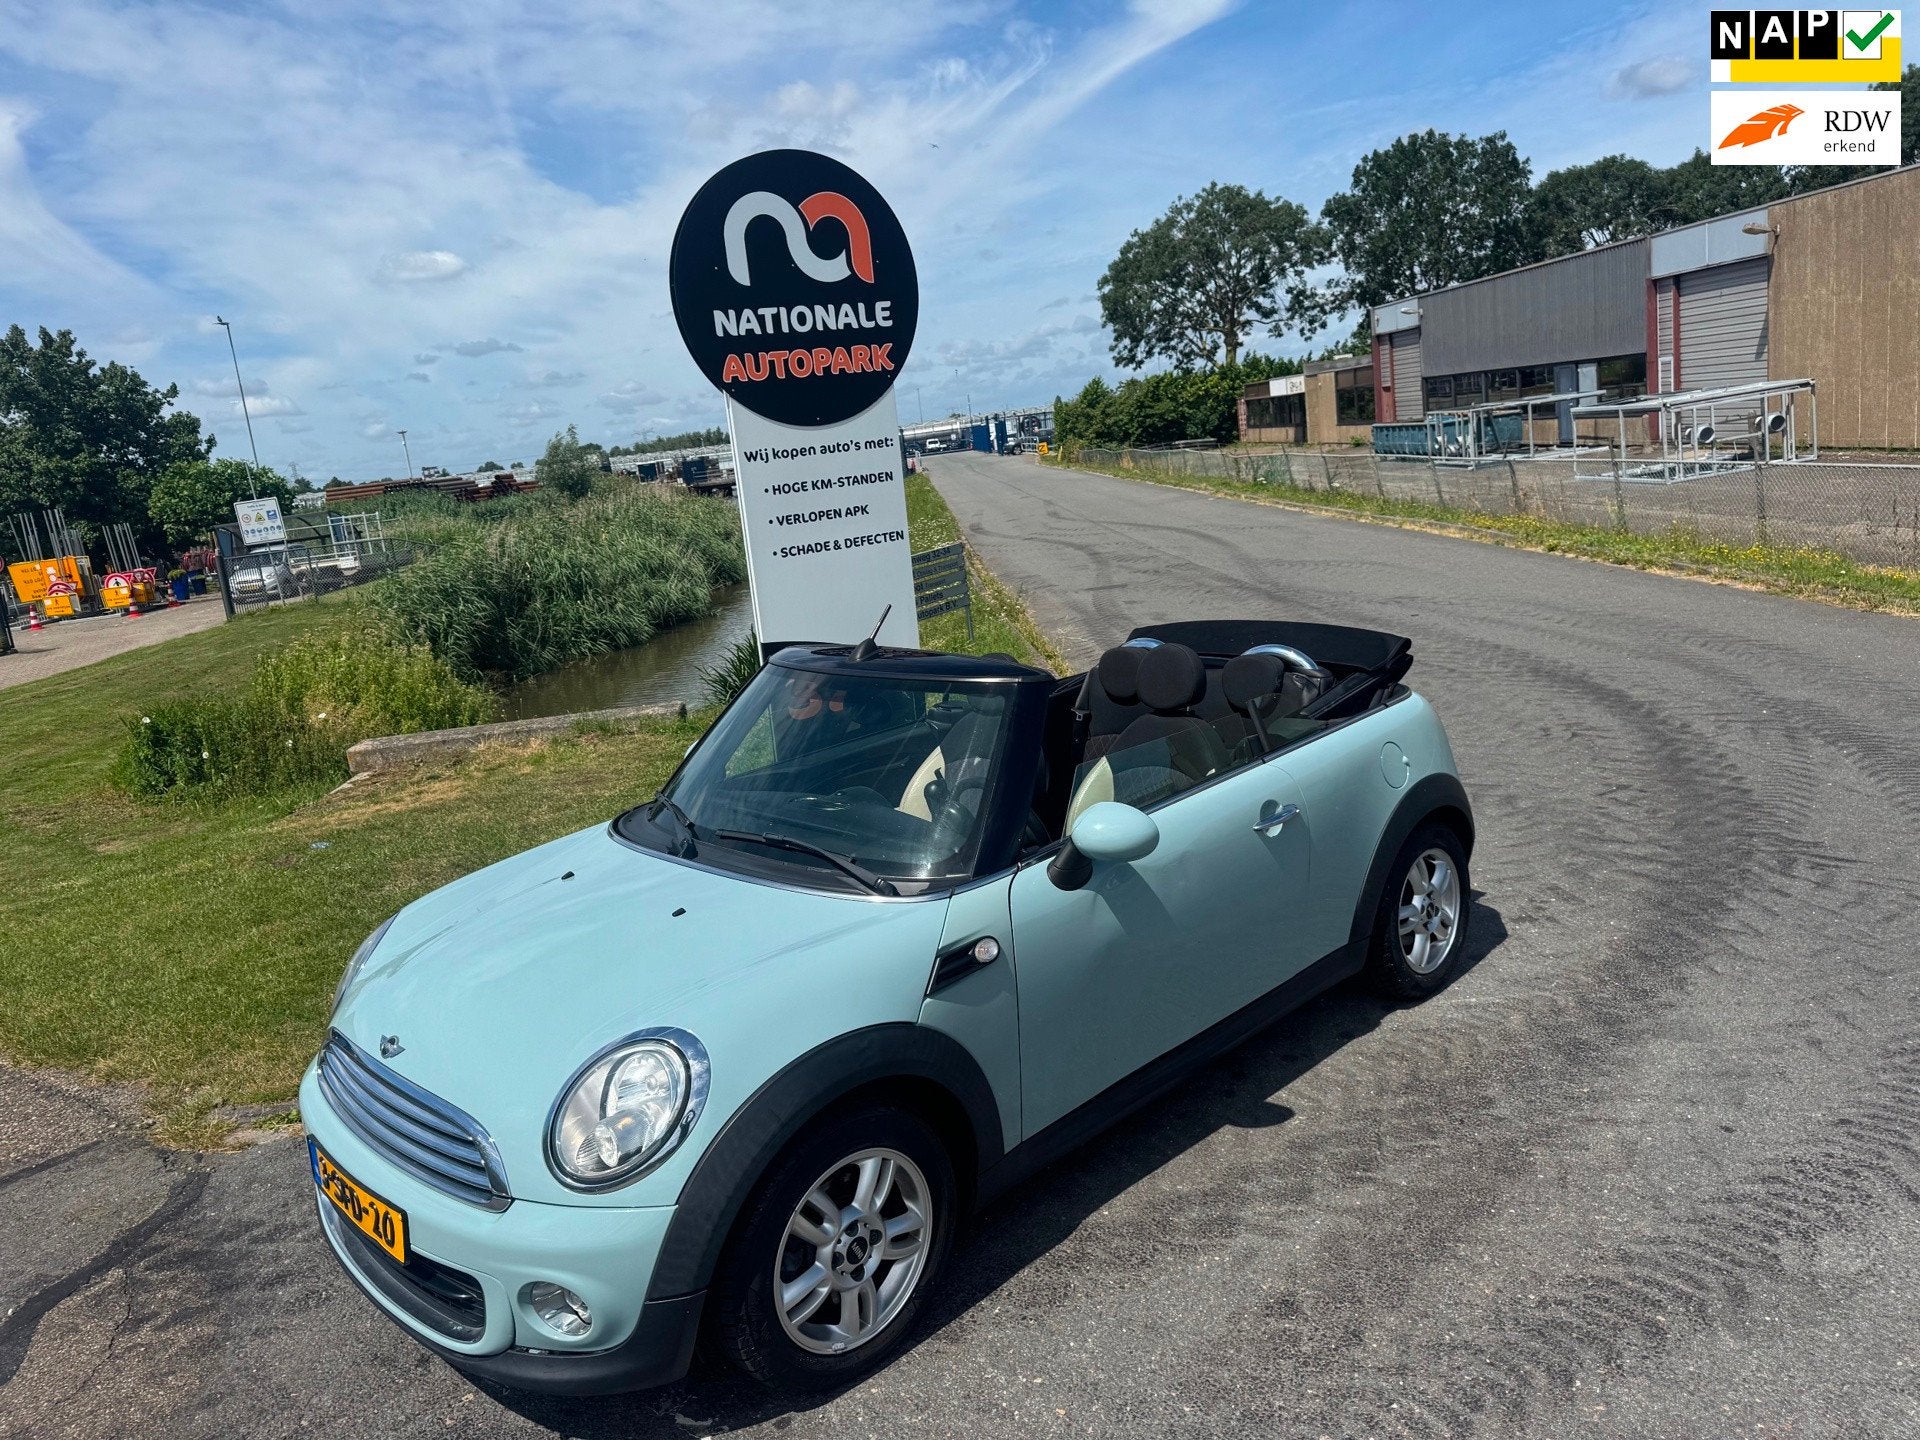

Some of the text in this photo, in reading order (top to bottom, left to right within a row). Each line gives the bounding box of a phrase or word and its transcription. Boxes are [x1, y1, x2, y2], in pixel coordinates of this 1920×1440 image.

[713, 300, 893, 337] NATIONALE
[722, 343, 895, 383] AUTOPARK
[744, 437, 894, 463] Wij kopen auto's met:
[772, 471, 894, 495] HOGE KM-STANDEN
[776, 504, 869, 526] VERLOPEN APK
[780, 530, 904, 558] SCHADE & DEFECTEN
